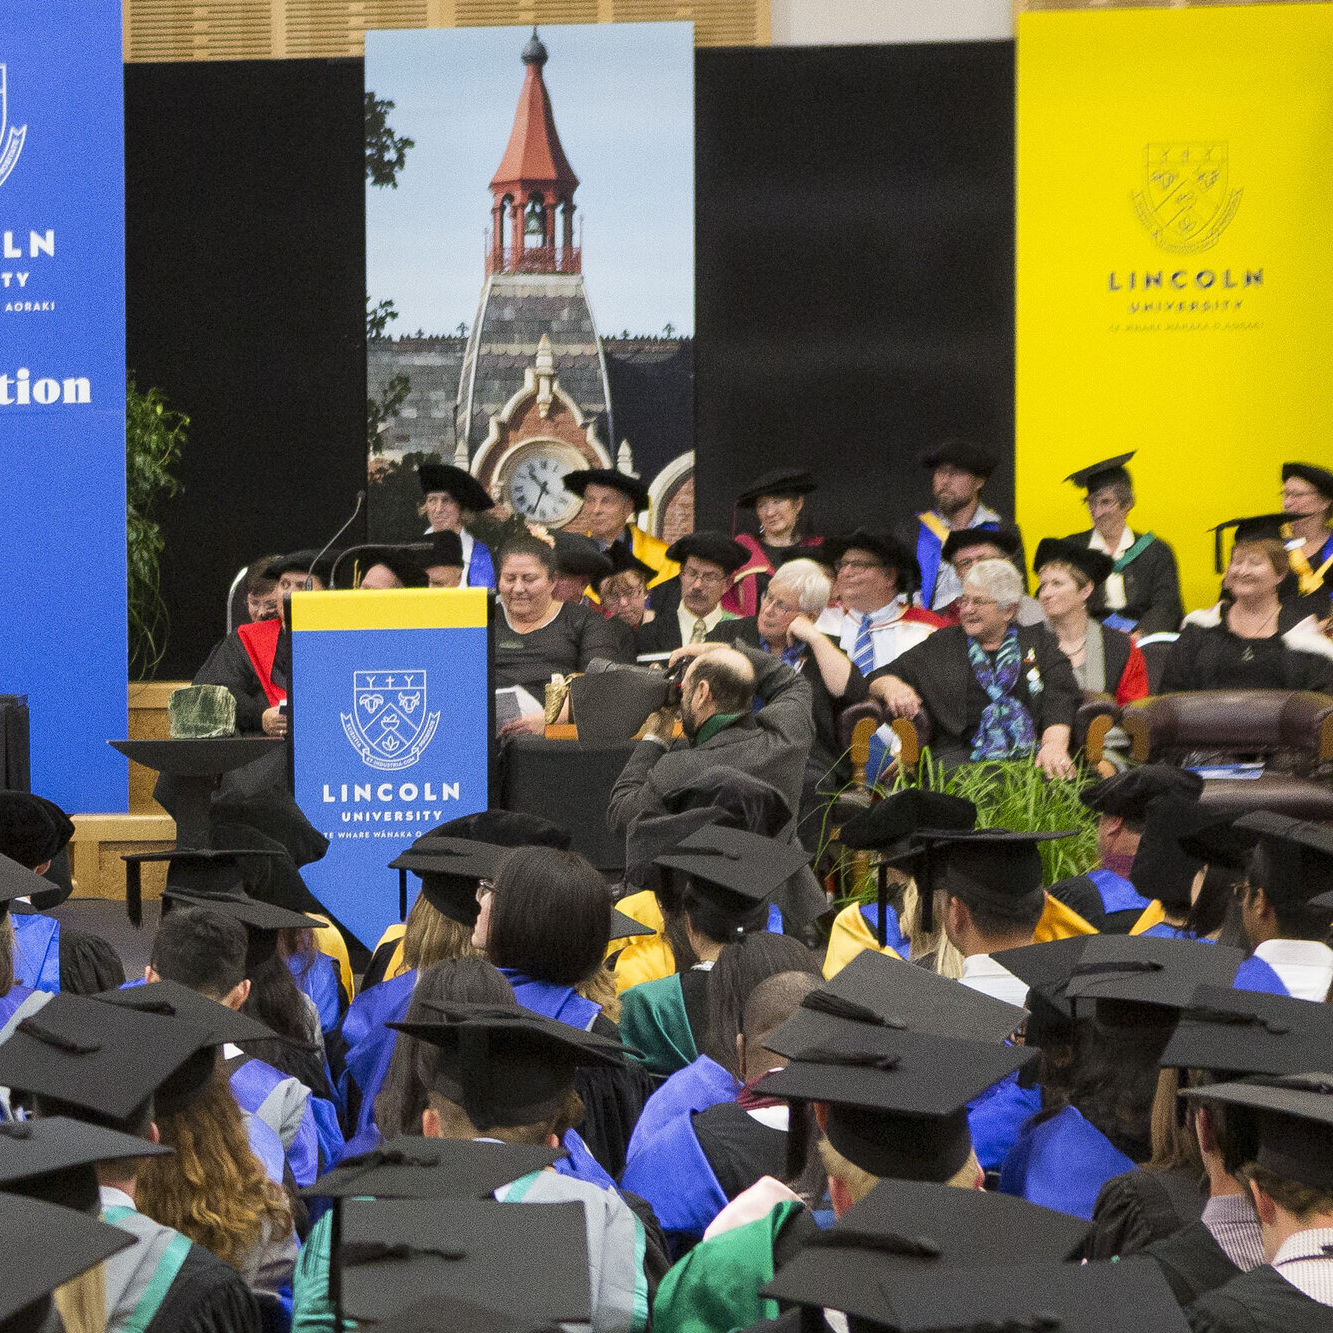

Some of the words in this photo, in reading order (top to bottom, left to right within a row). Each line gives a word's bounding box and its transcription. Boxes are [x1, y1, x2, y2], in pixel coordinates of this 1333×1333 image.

[1108, 268, 1263, 291] LINCOLN
[5, 301, 56, 312] AORAKI
[322, 782, 460, 802] LINCOLN
[341, 810, 442, 822] UNIVERSITY
